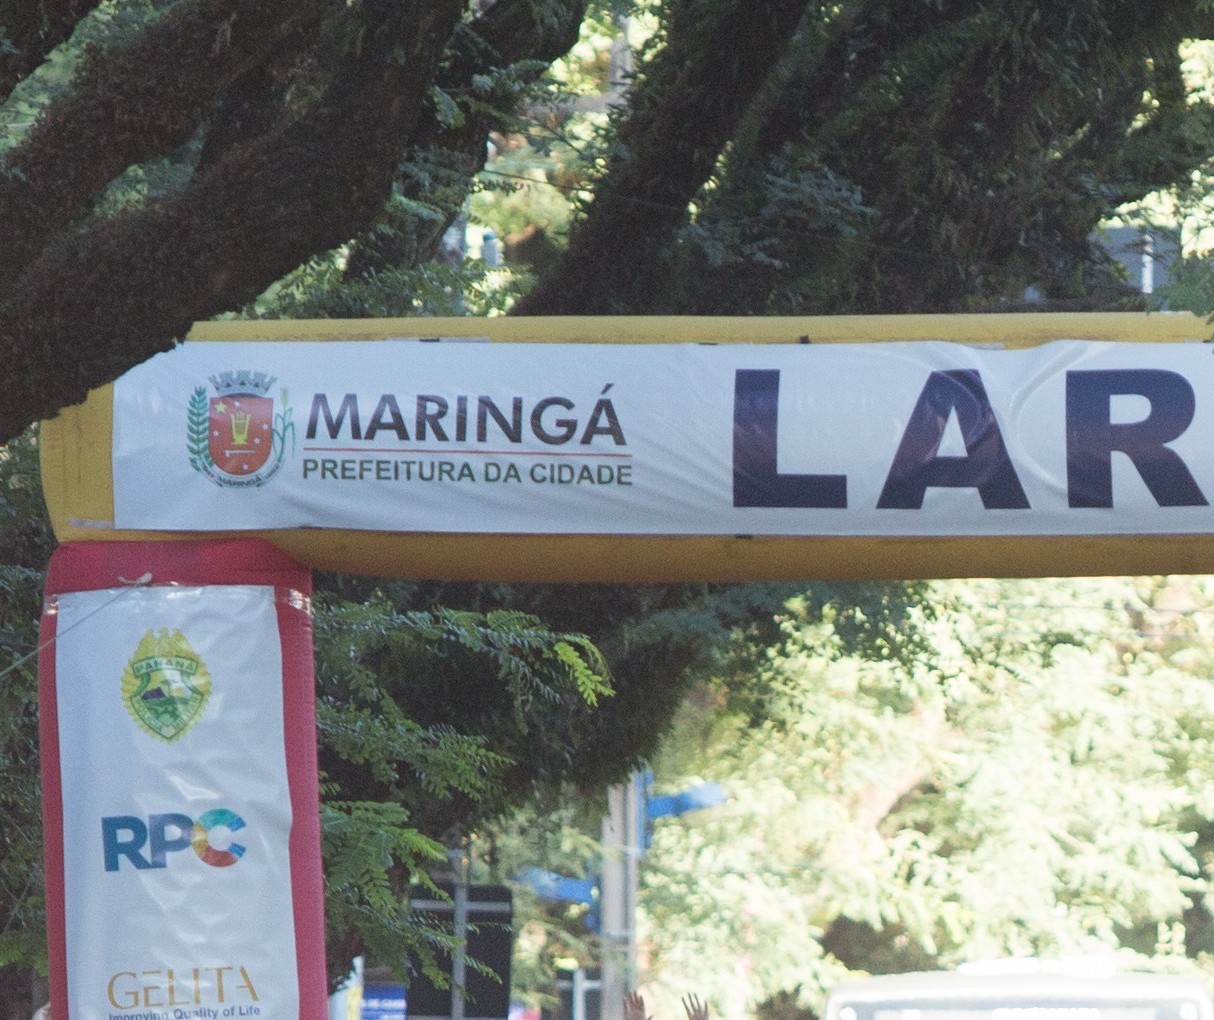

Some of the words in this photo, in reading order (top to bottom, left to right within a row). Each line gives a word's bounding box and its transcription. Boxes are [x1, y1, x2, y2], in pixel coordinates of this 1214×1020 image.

[305, 382, 628, 447] MARINGÁ
[303, 459, 477, 483] PREFEITURA
[484, 461, 523, 484] DA
[529, 462, 634, 486] CIDADE
[101, 808, 247, 872] RPC
[107, 965, 260, 1010] GELITA
[173, 1008, 219, 1020] Quality
[223, 1006, 236, 1017] of
[238, 1005, 261, 1016] Life
